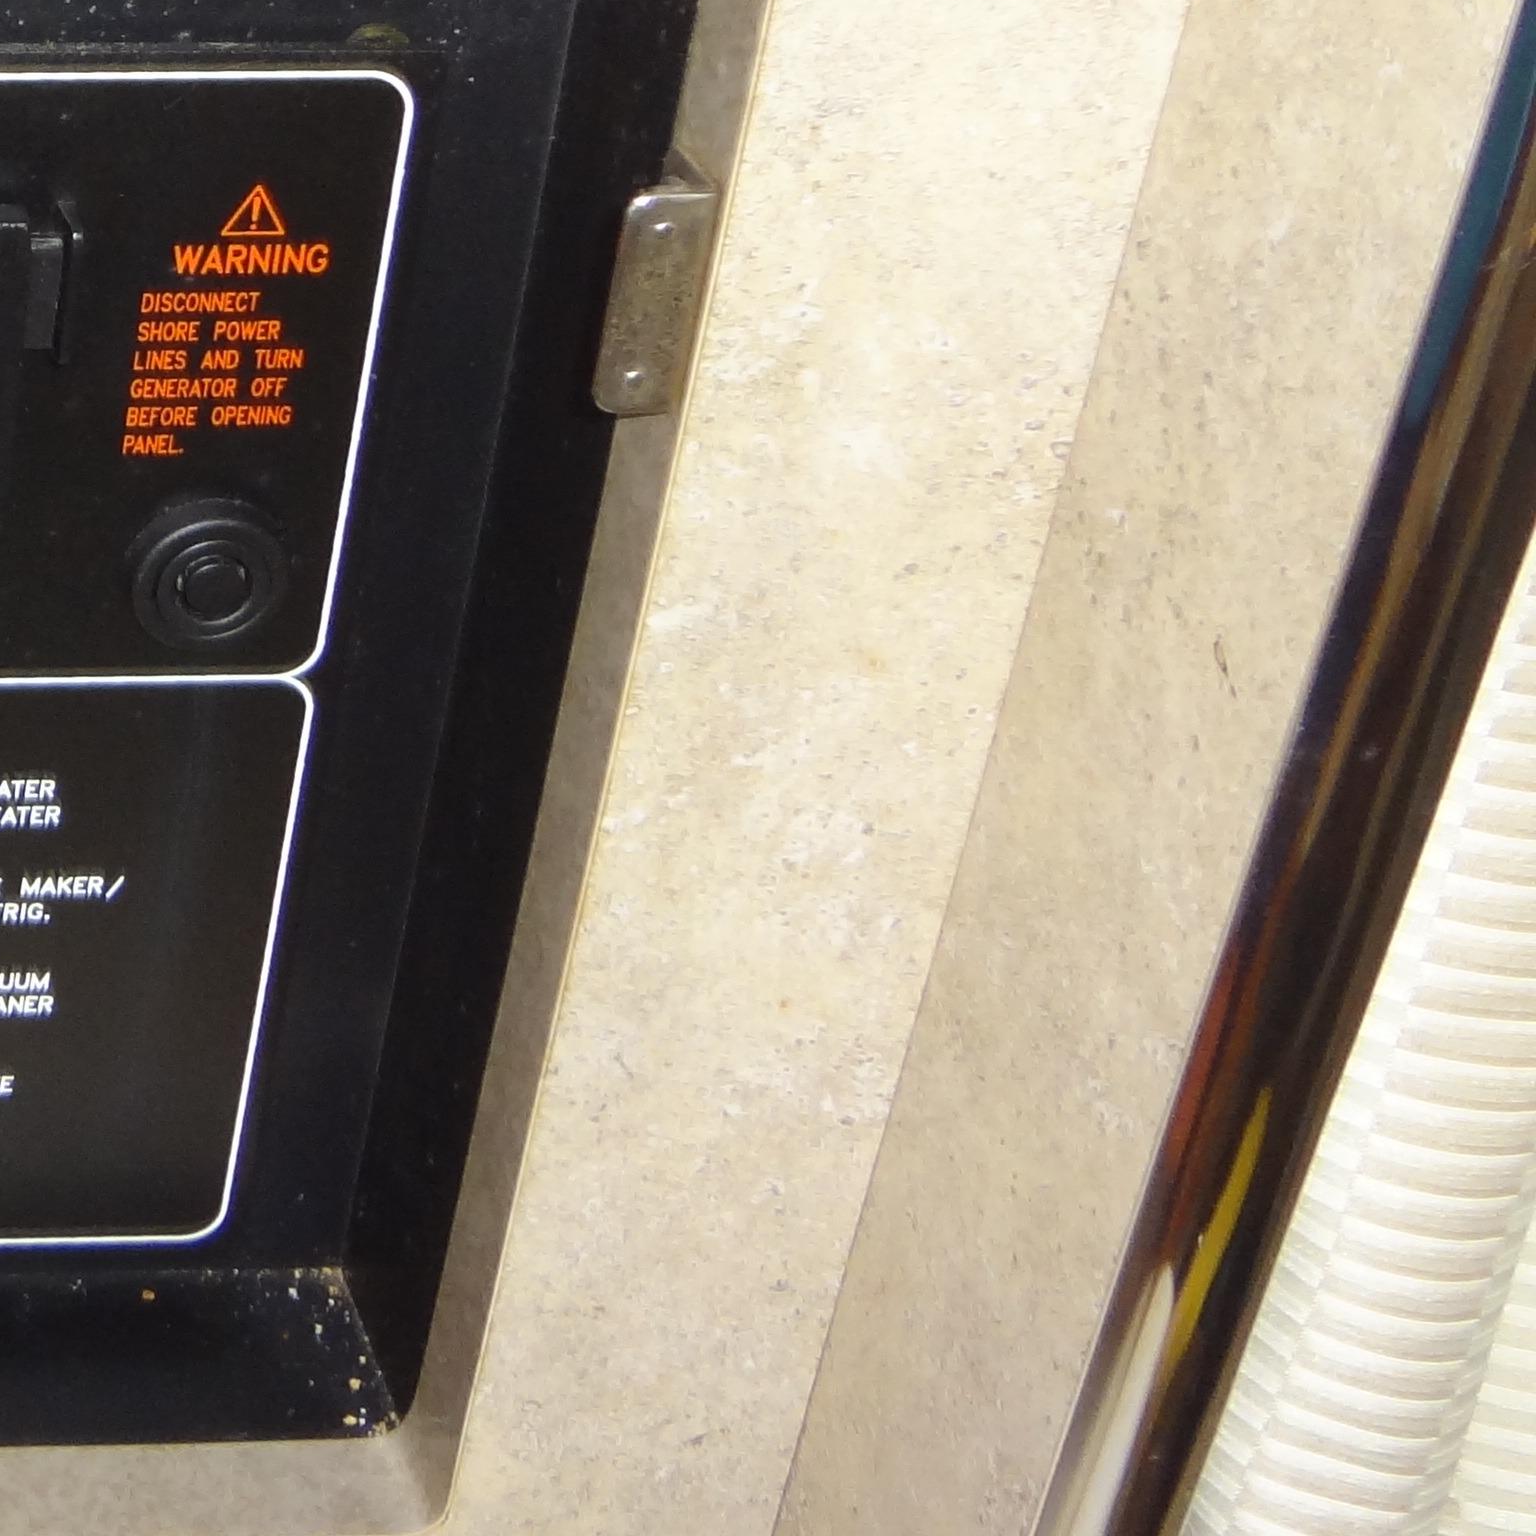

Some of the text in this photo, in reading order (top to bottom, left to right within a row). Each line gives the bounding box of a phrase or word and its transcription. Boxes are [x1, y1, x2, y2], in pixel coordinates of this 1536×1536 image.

[174, 243, 329, 274] WARNING
[140, 290, 261, 315] DISCONNECT
[138, 319, 282, 343] SHORE POWER
[133, 347, 305, 373] LINES AND TURN
[130, 375, 287, 401] GENERATOR OFF
[125, 404, 292, 429] BEFORE OPENING
[122, 433, 183, 456] PANEL.
[19, 875, 125, 899] MAKER/
